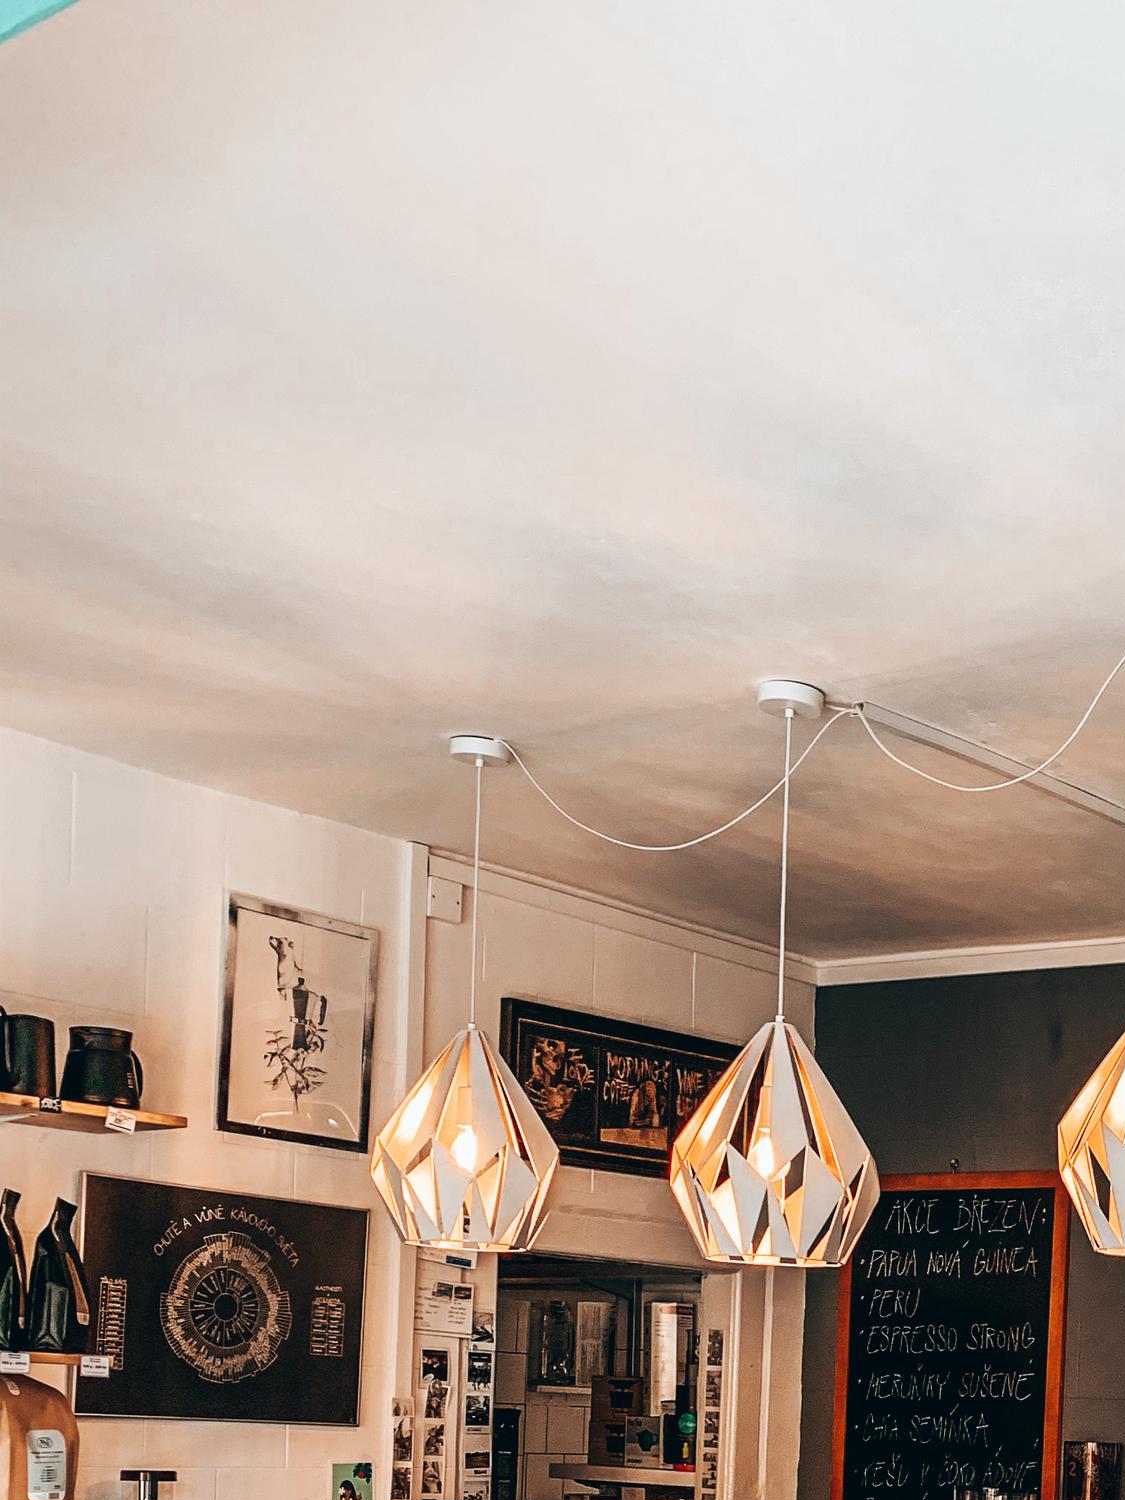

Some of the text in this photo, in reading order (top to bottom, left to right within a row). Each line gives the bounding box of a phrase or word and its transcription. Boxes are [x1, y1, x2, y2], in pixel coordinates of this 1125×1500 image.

[182, 1217, 192, 1230] A
[885, 1197, 940, 1234] AKCE
[867, 1240, 1038, 1279] PAPUA NOVÁ GUINEA
[869, 1288, 921, 1318] PERU
[866, 1321, 1035, 1354] ESPRESSO STRONG
